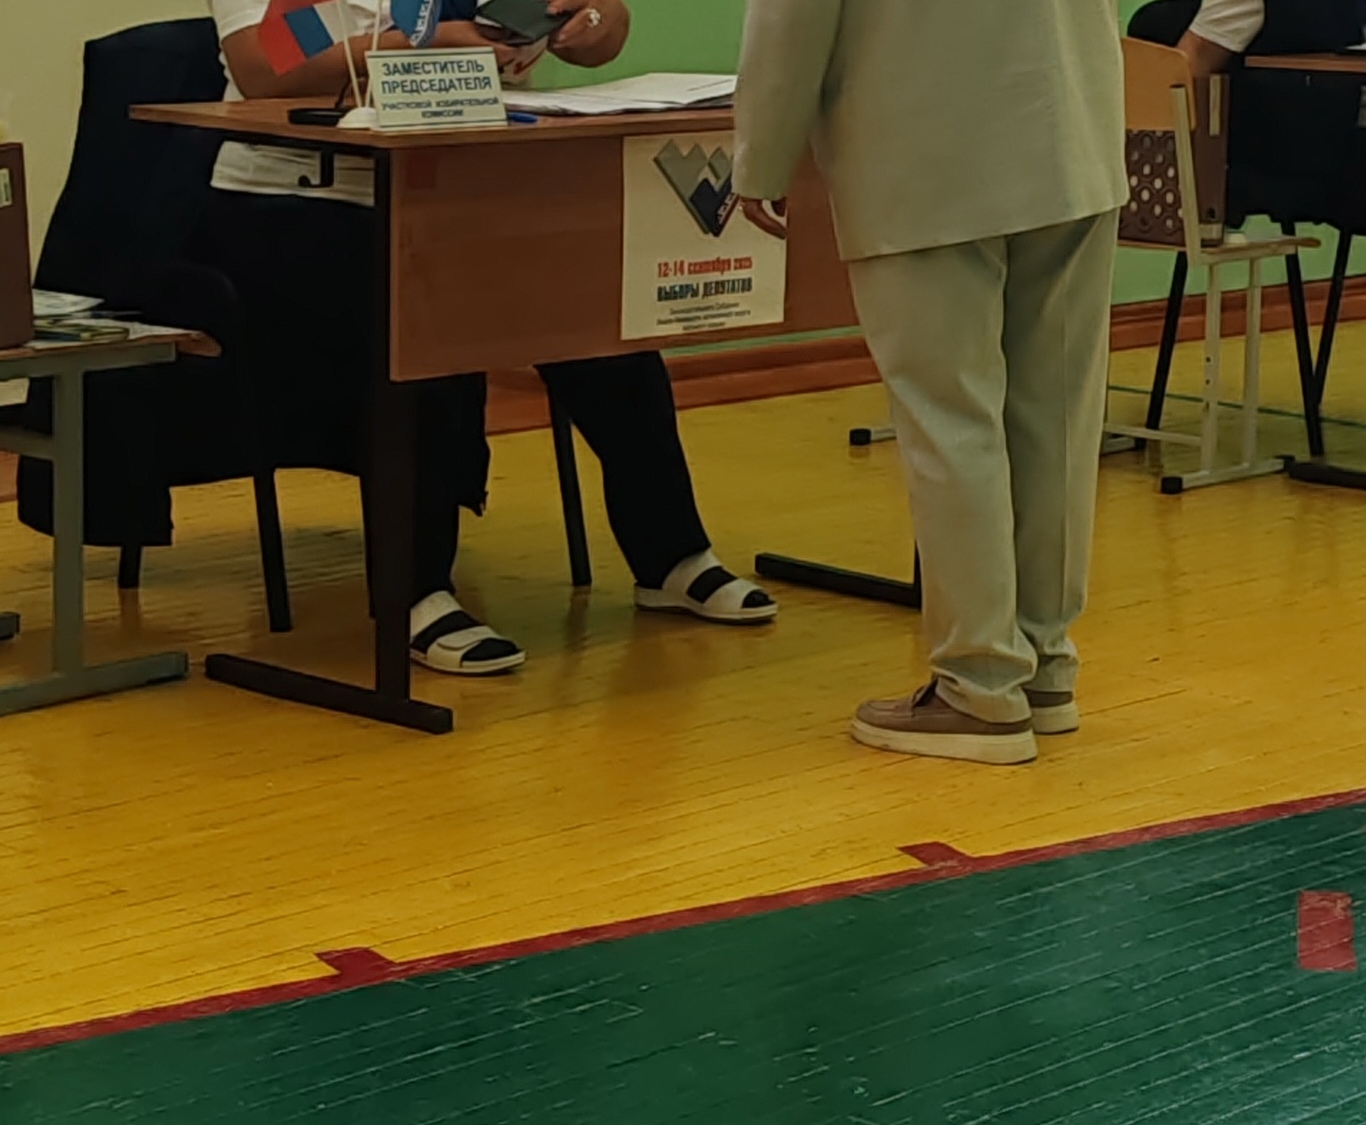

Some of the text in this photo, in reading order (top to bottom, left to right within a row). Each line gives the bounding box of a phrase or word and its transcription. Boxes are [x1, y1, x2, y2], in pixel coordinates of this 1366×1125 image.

[382, 60, 485, 76] ЗАМЕСТИТЕЛЬ
[381, 77, 492, 94] ПРЕДСЕДАТЕЛЯ
[657, 259, 685, 278] 12-14
[657, 277, 753, 302] ВЫБОРЫ ДЕПУТАТОВ
